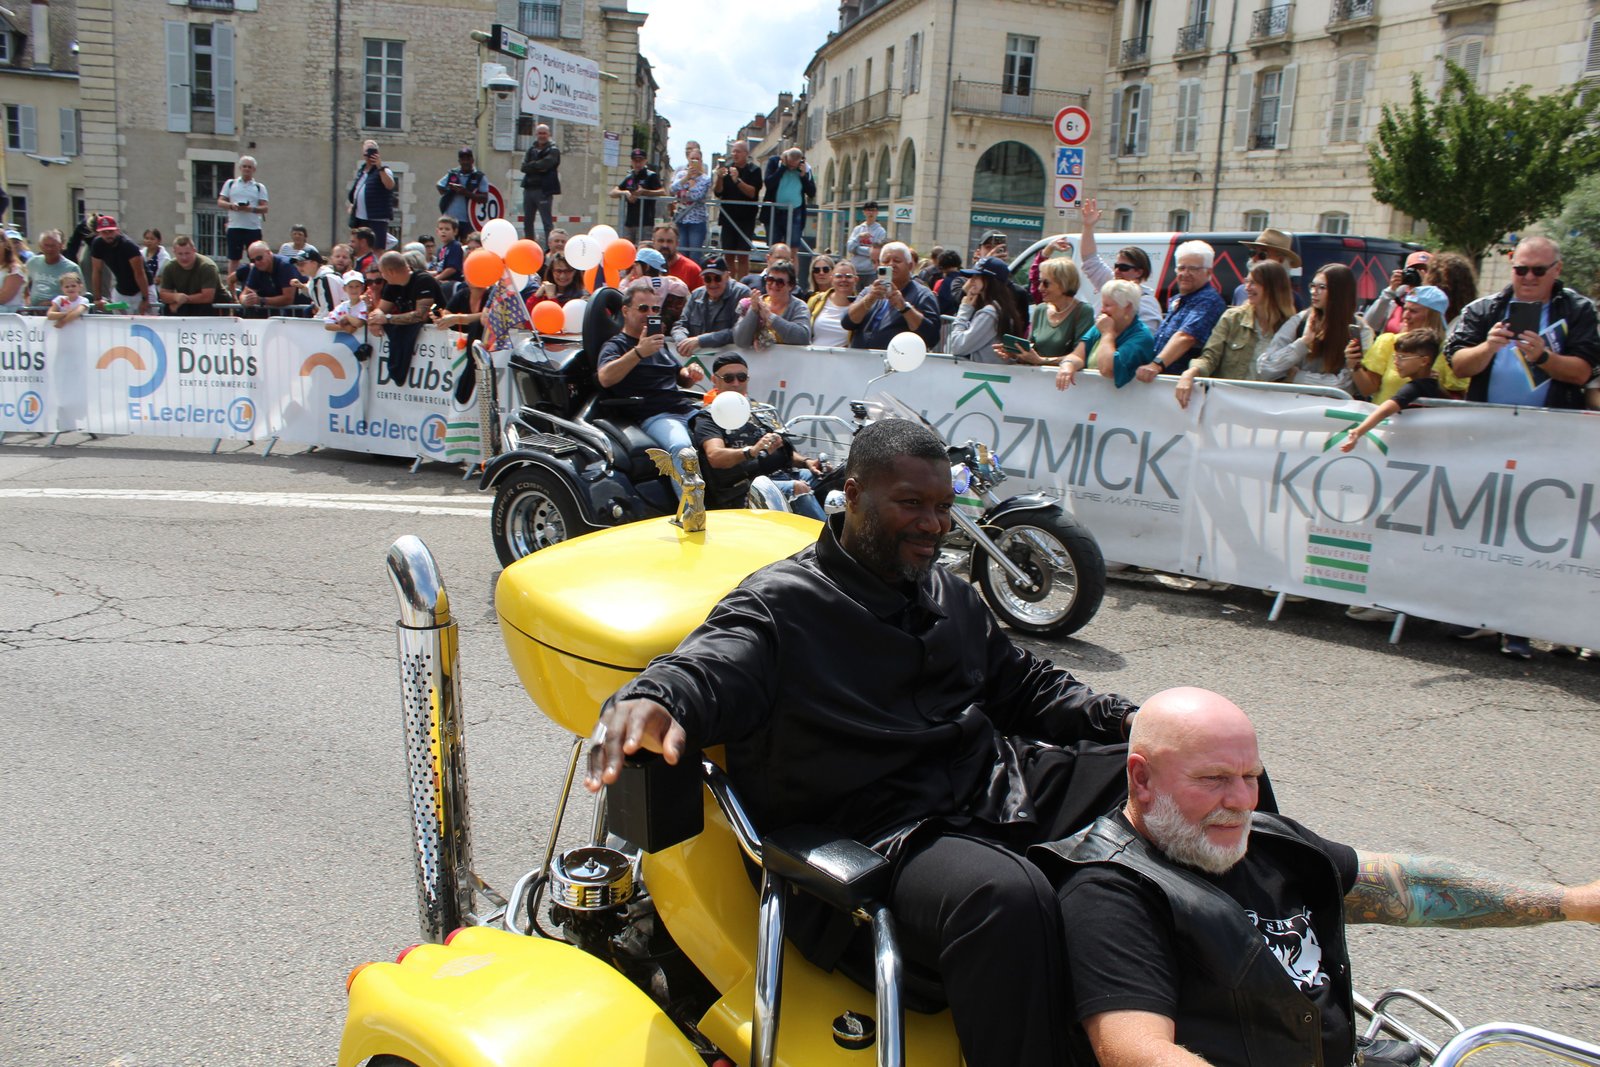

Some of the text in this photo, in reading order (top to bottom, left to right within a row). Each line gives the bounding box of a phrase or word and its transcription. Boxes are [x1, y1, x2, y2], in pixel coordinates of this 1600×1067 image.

[543, 74, 555, 94] 30
[1066, 121, 1073, 131] 6
[477, 203, 498, 221] 30
[972, 214, 1041, 227] CRÉDIT AGRICOLE
[29, 327, 45, 342] du
[177, 328, 257, 346] les rives du
[178, 347, 258, 377] Doubs
[377, 356, 454, 392] Dubs
[179, 379, 257, 389] CENTRE COMMERCIAL
[376, 391, 451, 407] CENTRE COMMERCIAL
[128, 402, 226, 424] E.Leclerc
[329, 413, 418, 442] E.Leclerc
[495, 482, 551, 536] COOPER COBRA
[1310, 525, 1373, 541] CHARPENTE
[1307, 543, 1372, 562] COUVERTURE
[1423, 541, 1444, 552] LA
[1304, 566, 1367, 583] ZINGUERIE
